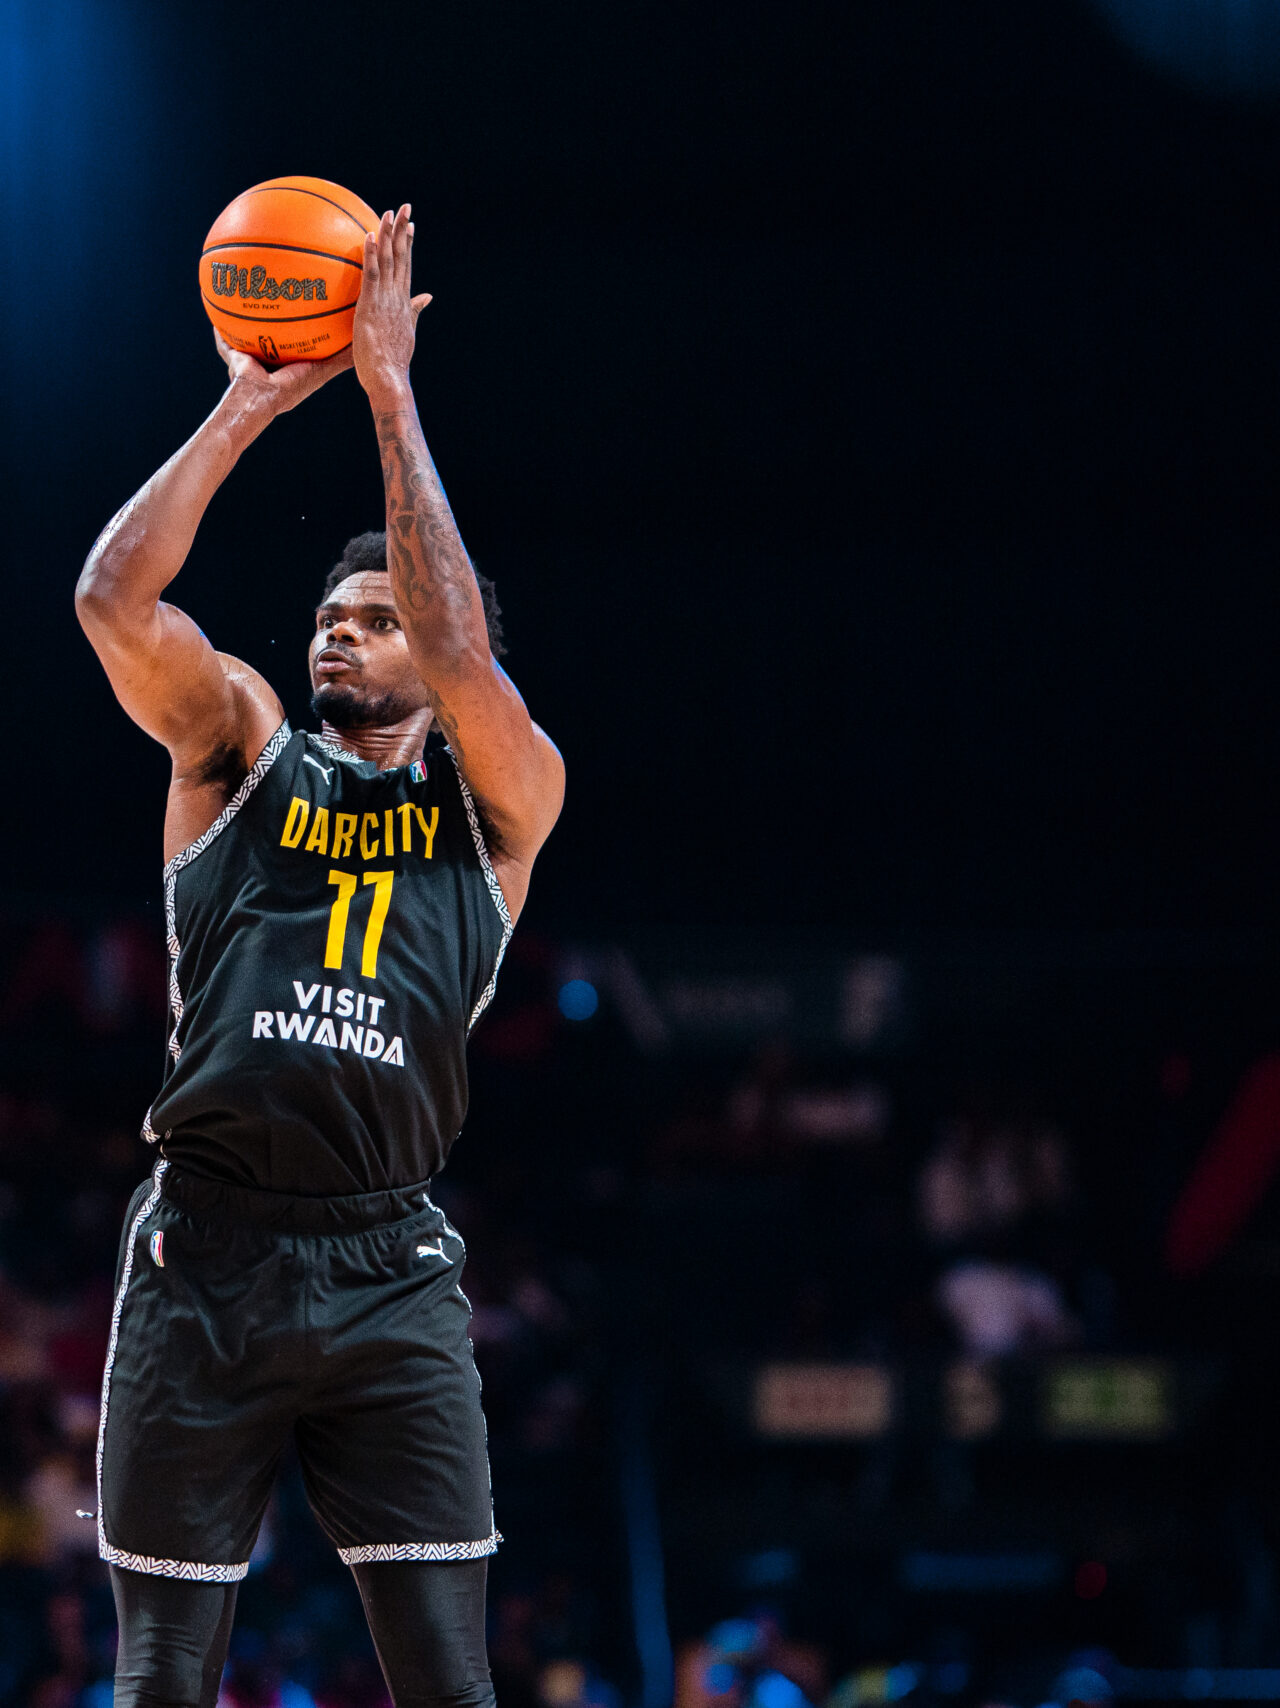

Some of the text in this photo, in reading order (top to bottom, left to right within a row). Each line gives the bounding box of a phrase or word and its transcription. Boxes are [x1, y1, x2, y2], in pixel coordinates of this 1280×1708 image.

[211, 261, 328, 301] Wilson
[280, 796, 440, 861] DARCITY
[324, 869, 395, 979] 11
[293, 980, 386, 1025] VISIT
[252, 1011, 405, 1067] RWANDA
